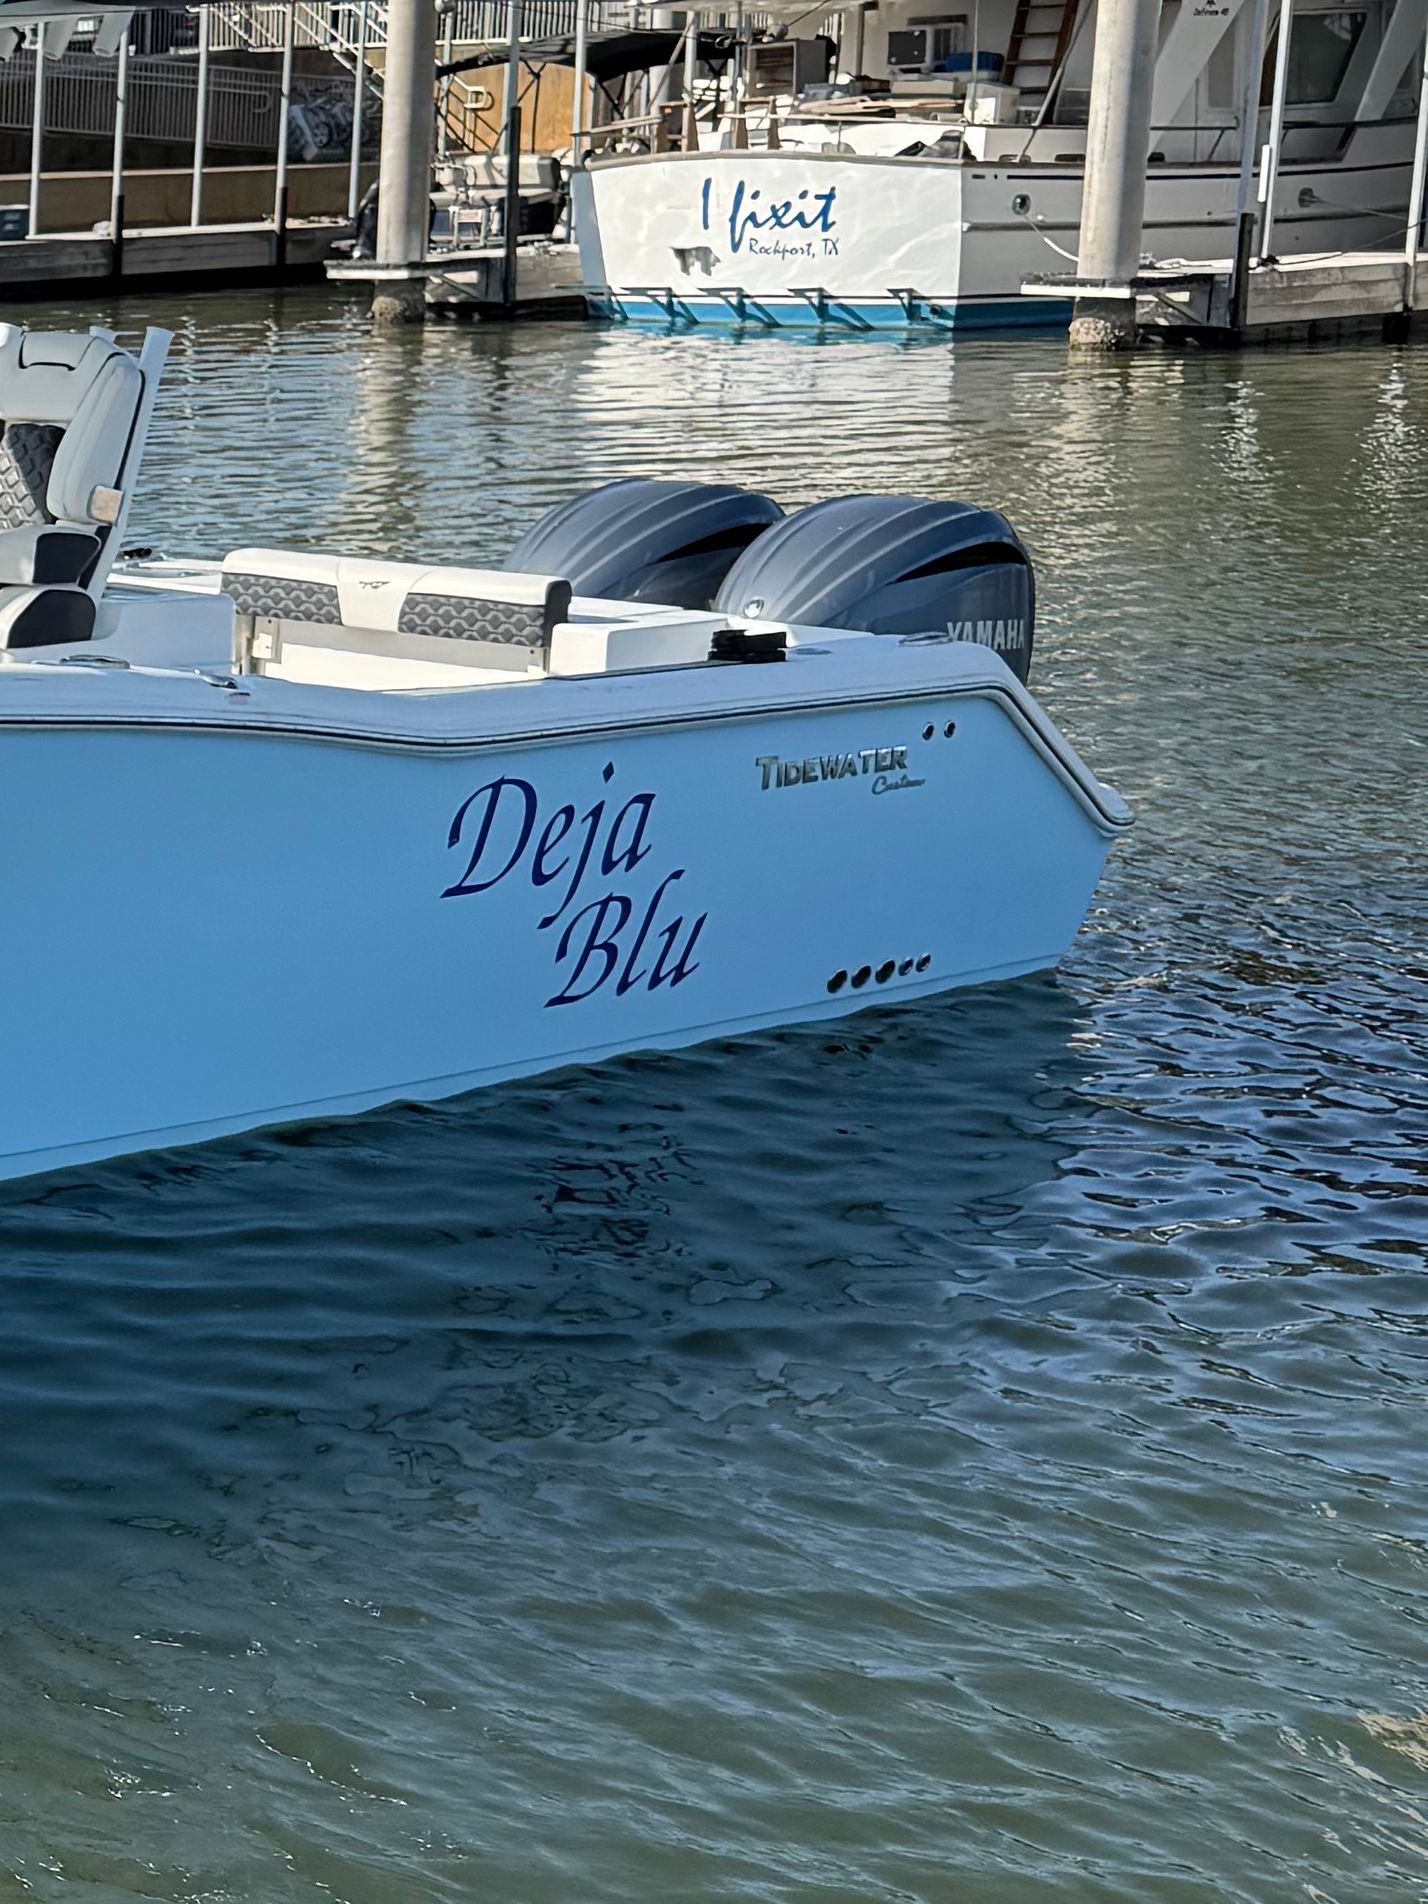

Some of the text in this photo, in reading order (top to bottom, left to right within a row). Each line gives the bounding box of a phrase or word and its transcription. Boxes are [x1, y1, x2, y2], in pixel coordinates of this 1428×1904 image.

[701, 177, 837, 254] I fixit
[821, 237, 839, 256] TX
[946, 619, 1025, 650] YAMAHA
[440, 760, 656, 930] Deja
[543, 869, 708, 1008] Blu
